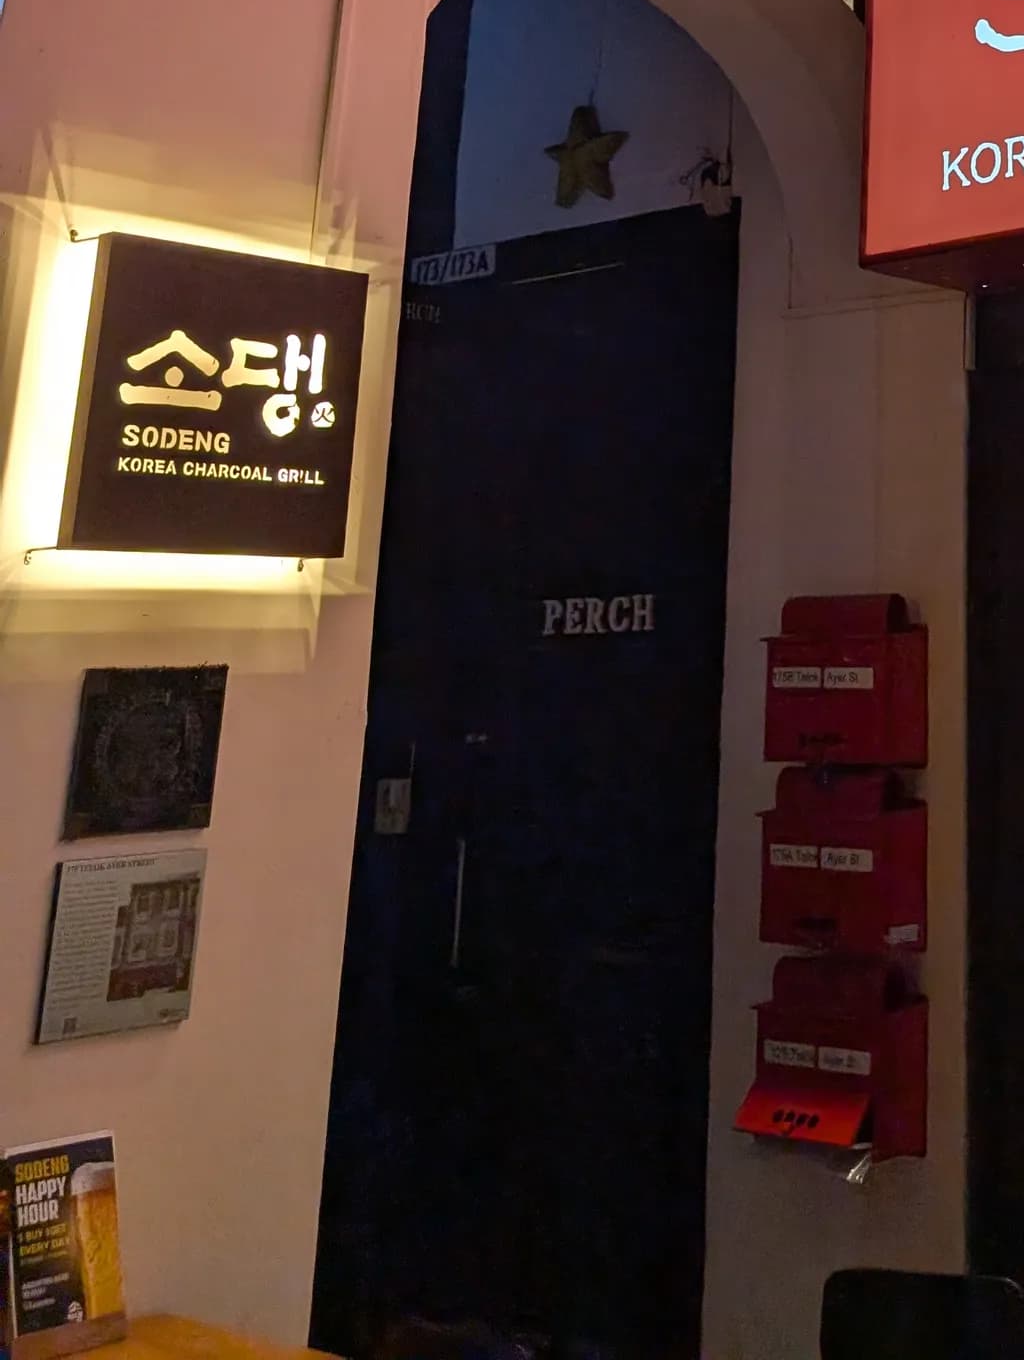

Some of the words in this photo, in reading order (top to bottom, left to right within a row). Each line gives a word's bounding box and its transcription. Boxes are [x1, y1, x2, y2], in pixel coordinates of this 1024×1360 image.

[417, 251, 488, 282] 173/173A
[119, 330, 327, 438] 소댕
[122, 424, 231, 454] SODENG
[117, 456, 178, 475] KOREA
[182, 461, 272, 482] CHARCOAL
[277, 468, 325, 485] GRILL
[542, 594, 655, 637] PERCH
[15, 1154, 69, 1184] SODENG
[16, 1175, 66, 1206] HAPPY
[17, 1198, 59, 1228] HOUR
